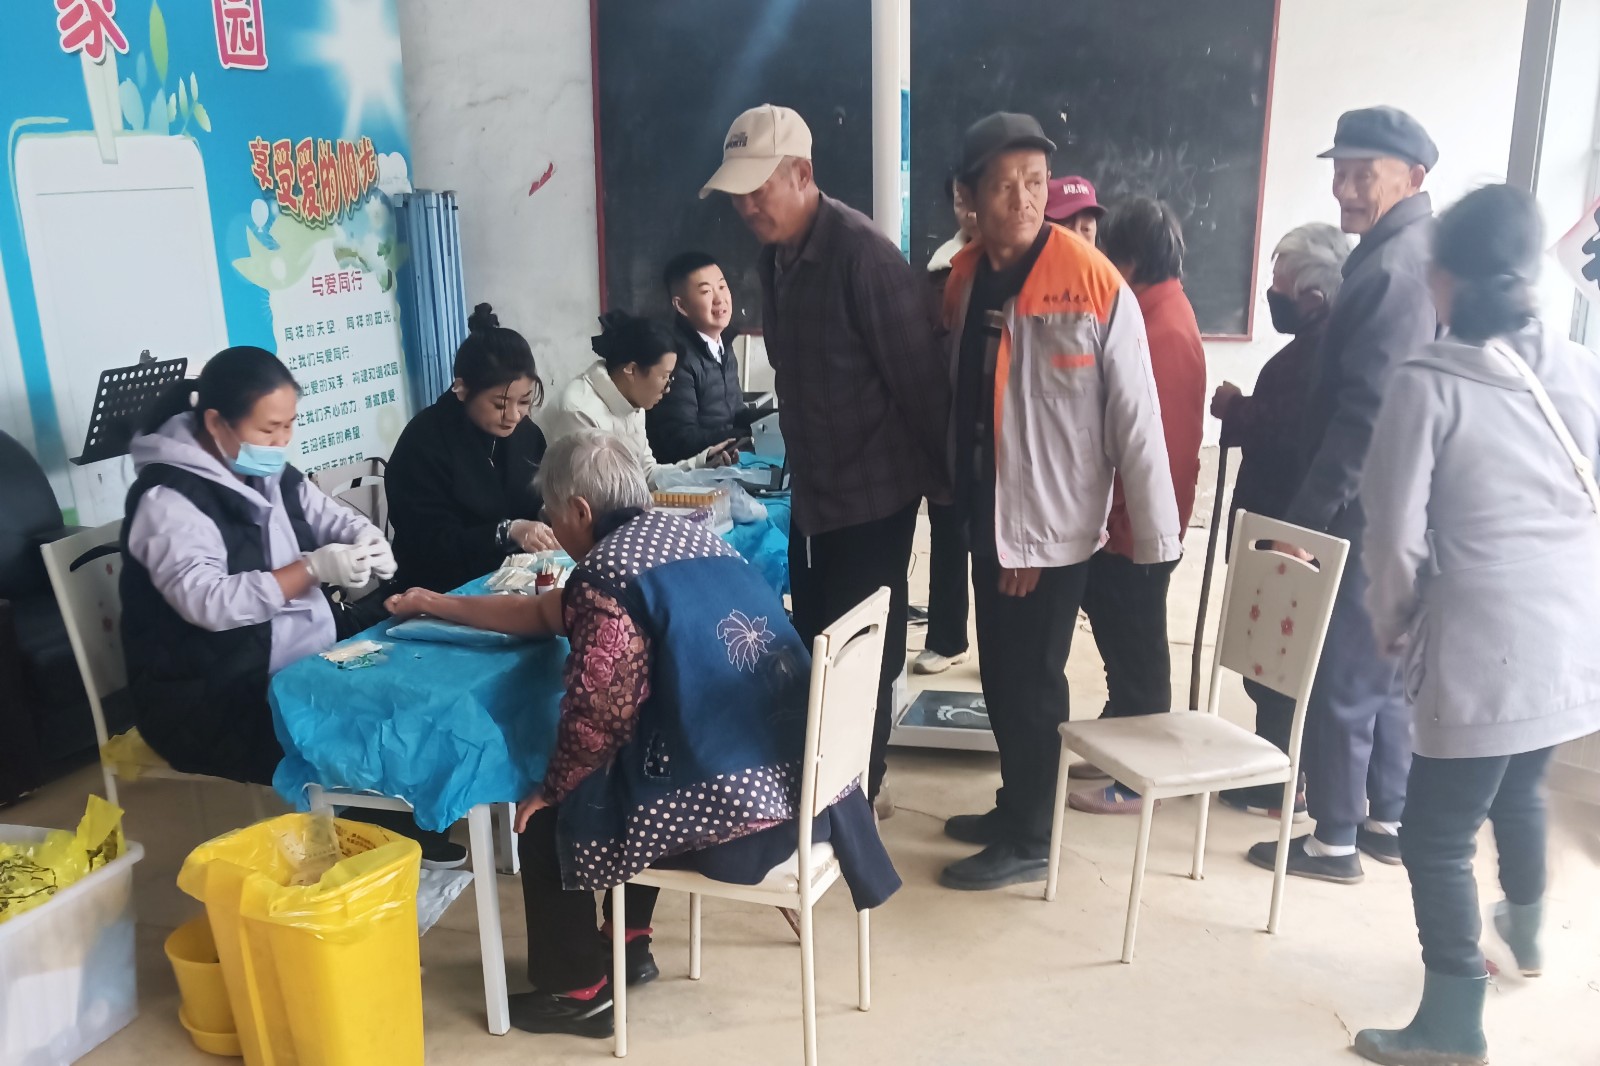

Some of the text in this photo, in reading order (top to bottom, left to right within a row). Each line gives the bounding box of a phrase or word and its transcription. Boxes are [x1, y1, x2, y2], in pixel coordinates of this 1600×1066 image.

[249, 136, 378, 220] 享受爱的阳光
[311, 270, 363, 297] 与爱同行
